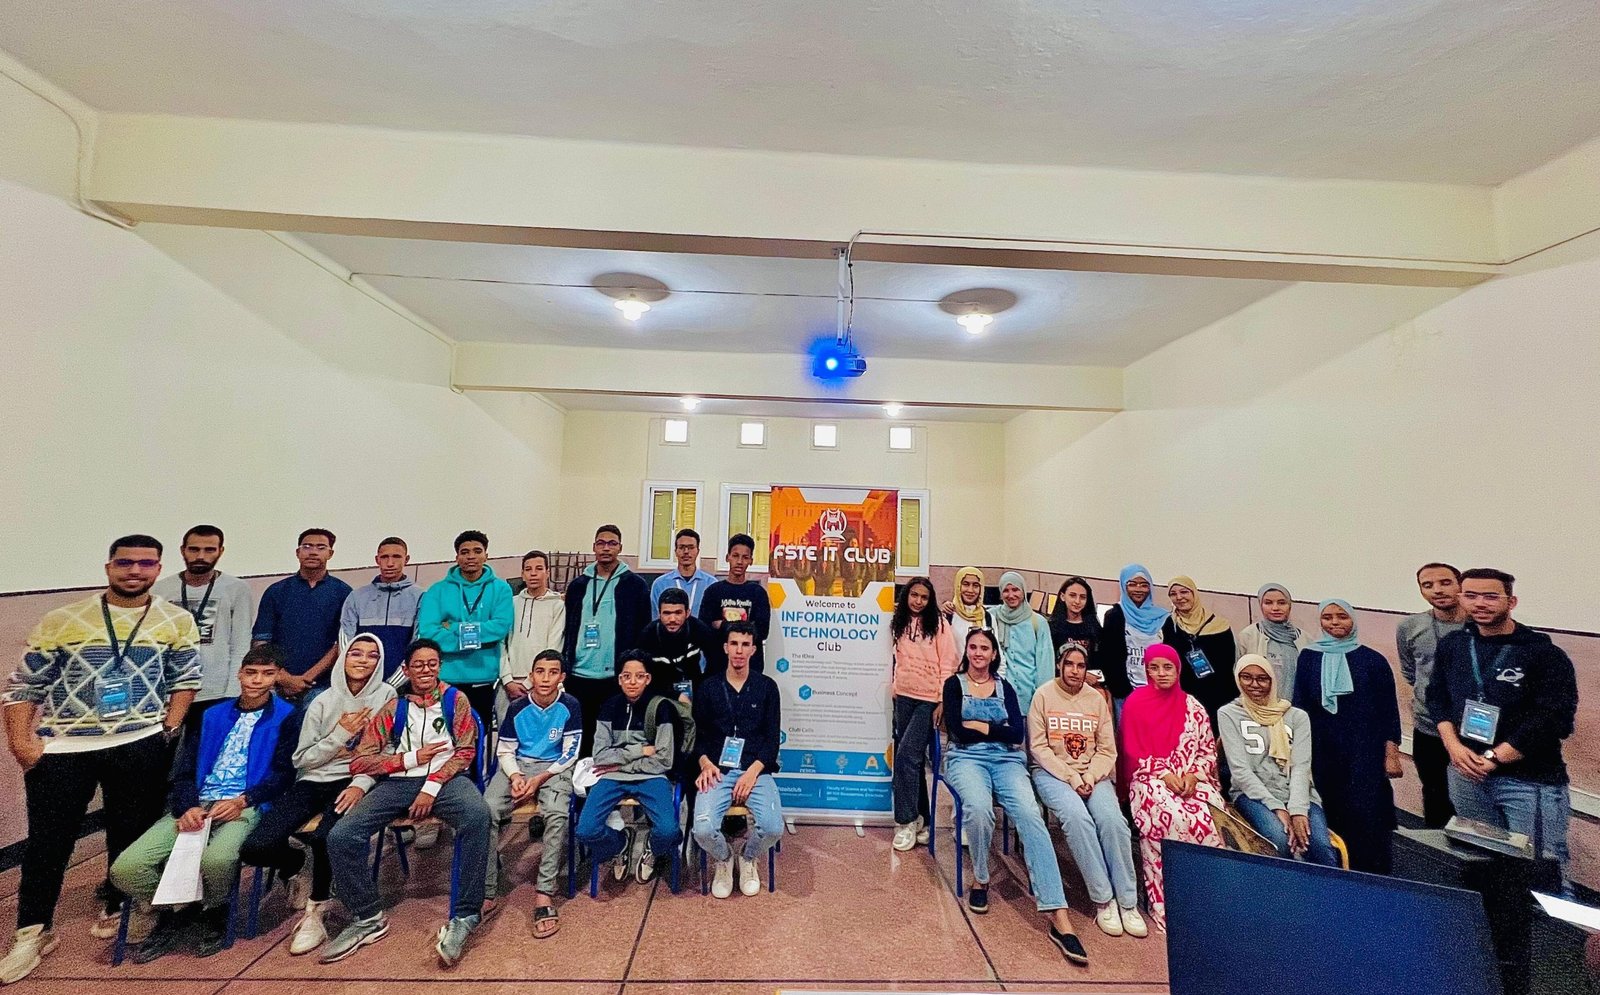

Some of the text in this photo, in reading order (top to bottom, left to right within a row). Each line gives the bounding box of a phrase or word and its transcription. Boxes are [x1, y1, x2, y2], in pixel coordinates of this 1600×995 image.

[773, 545, 891, 563] FSTE IT CLUB
[805, 600, 856, 609] Welcome to
[781, 611, 879, 625] INFORMATION
[782, 626, 878, 640] TECHNOLOGY
[817, 642, 842, 652] Club
